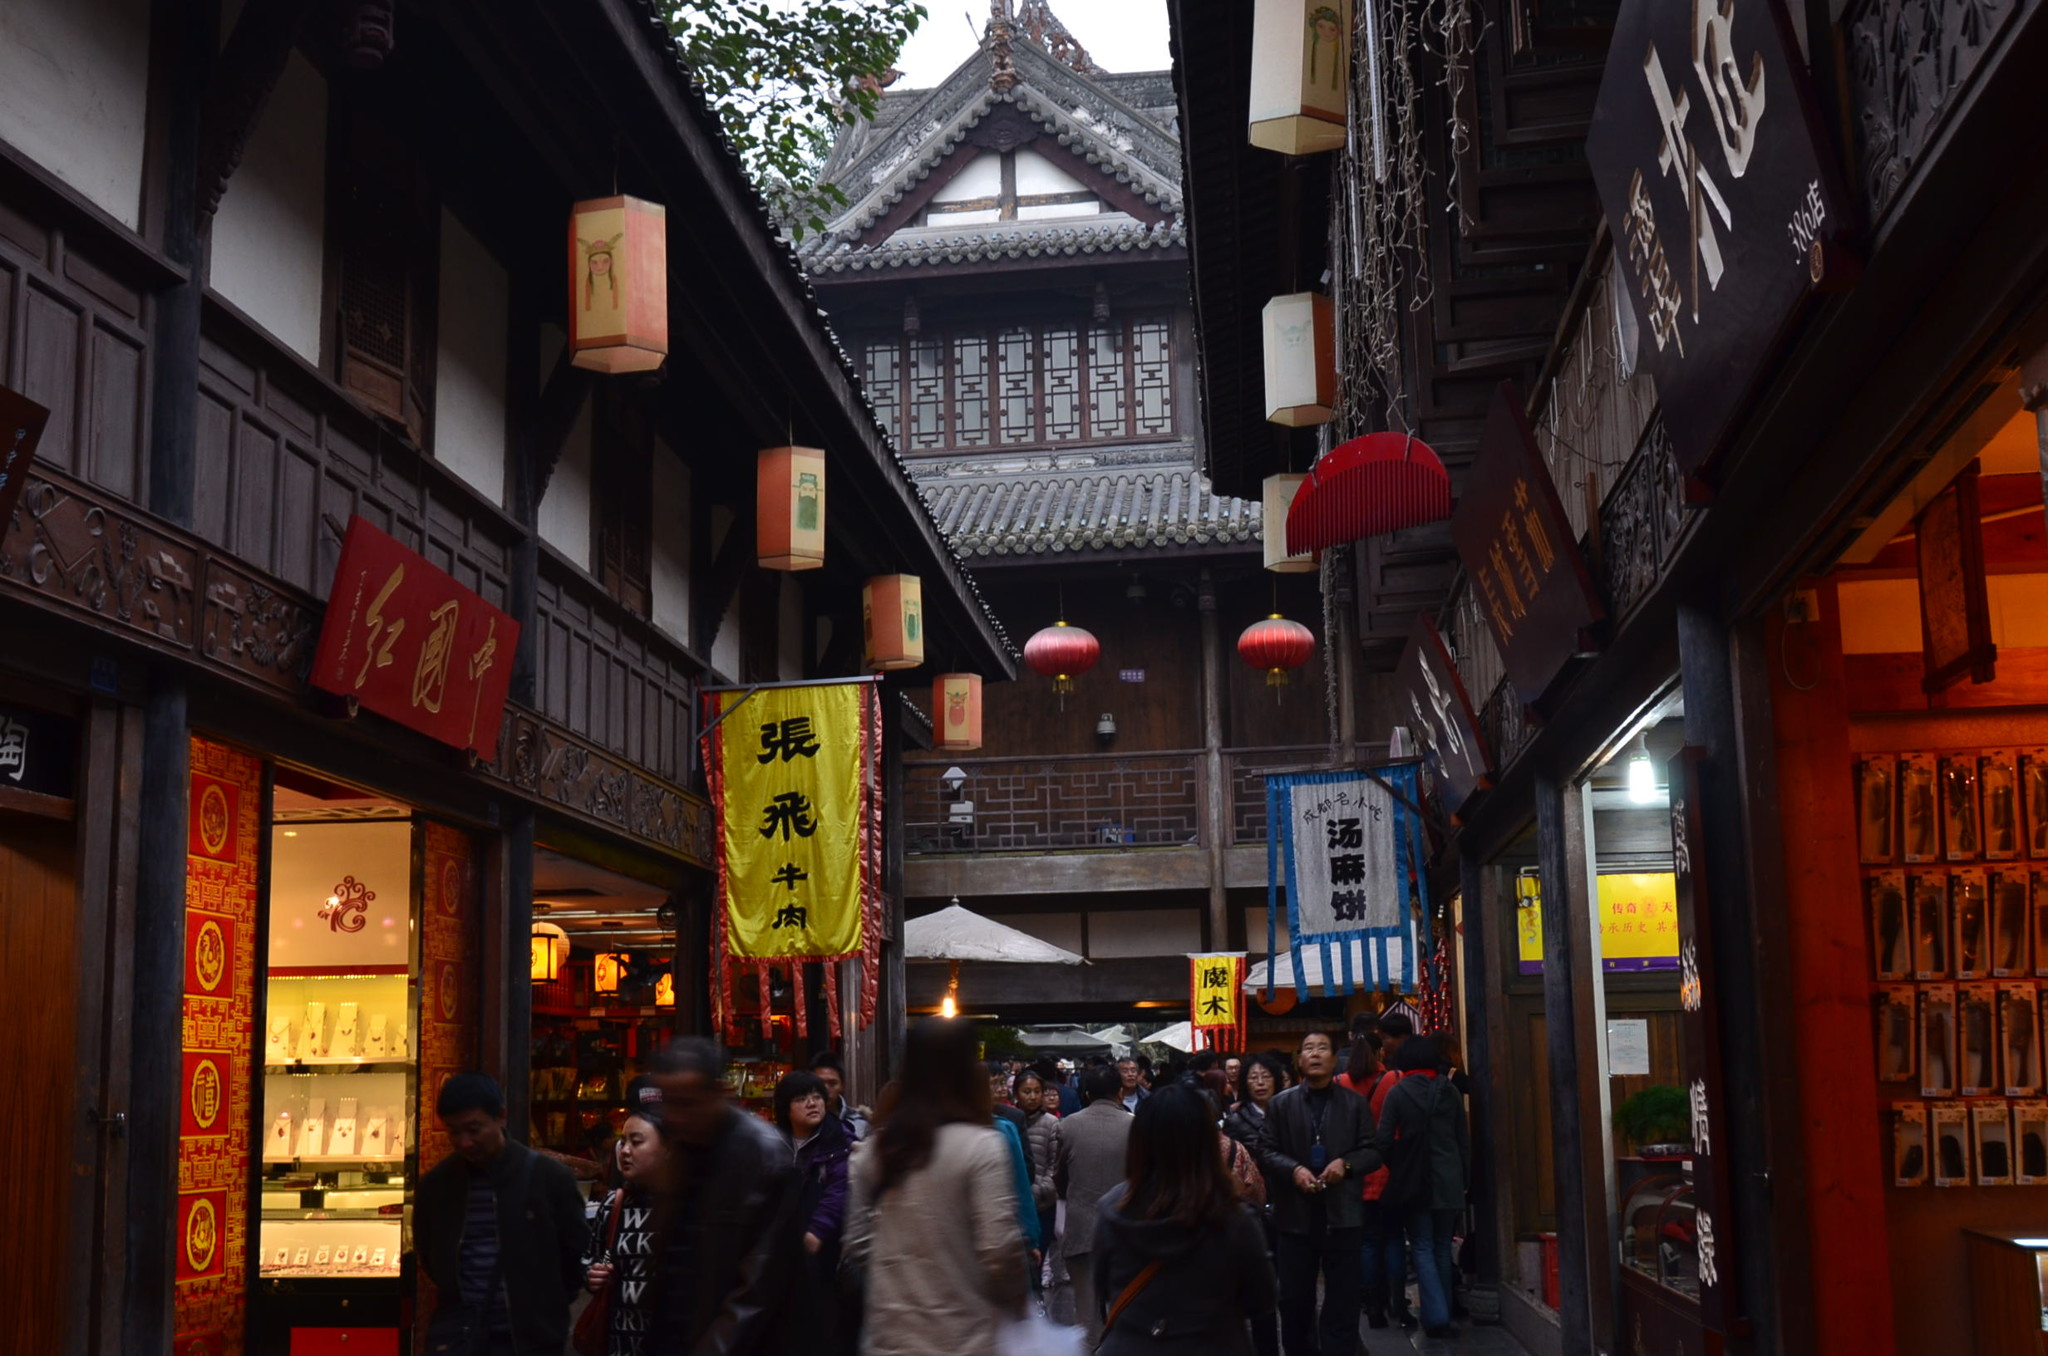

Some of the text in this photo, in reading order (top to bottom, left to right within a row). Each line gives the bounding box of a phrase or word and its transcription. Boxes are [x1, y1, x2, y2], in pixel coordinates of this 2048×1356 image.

[1788, 178, 1826, 265] 386店
[757, 716, 821, 930] 張飛牛肉
[1303, 792, 1383, 825] 成都名小吃
[1327, 818, 1367, 921] 汤麻饼
[1202, 966, 1229, 1016] 魔术
